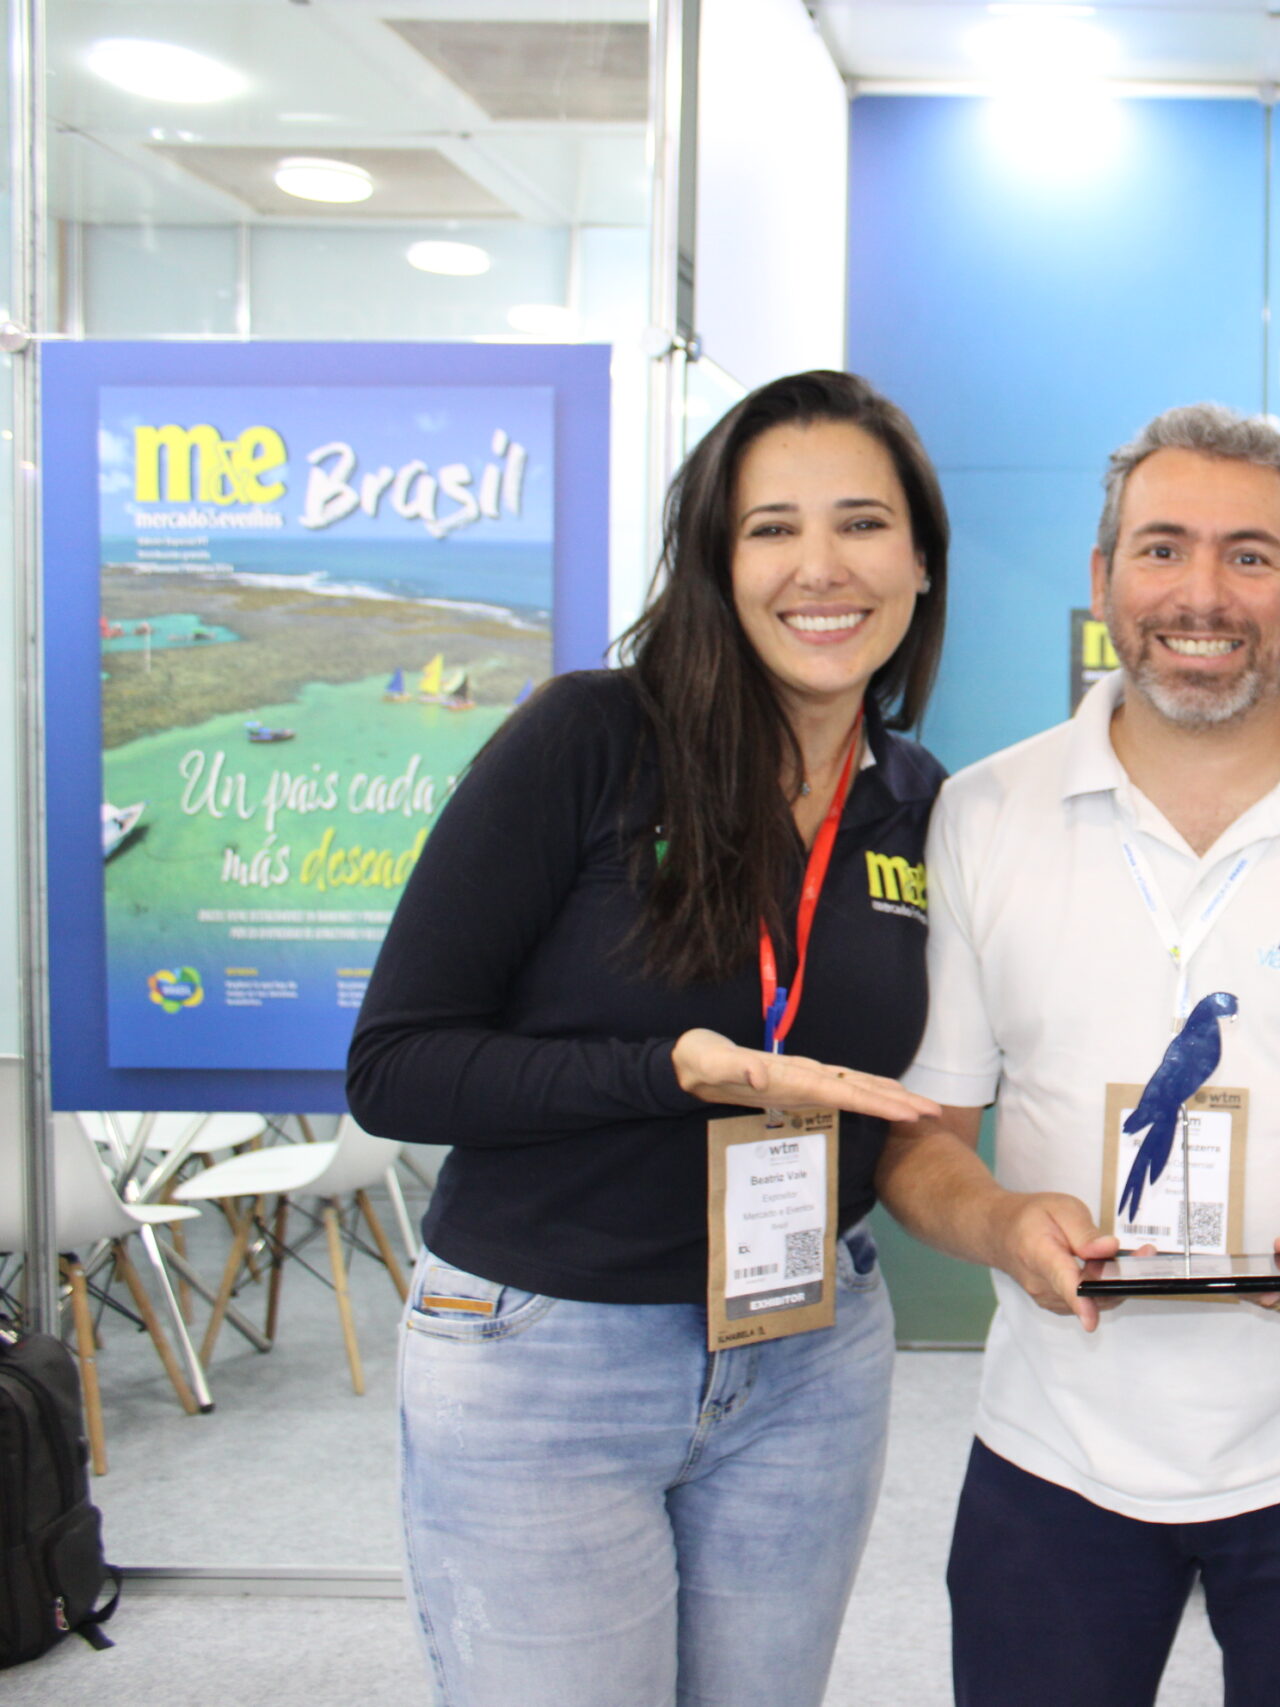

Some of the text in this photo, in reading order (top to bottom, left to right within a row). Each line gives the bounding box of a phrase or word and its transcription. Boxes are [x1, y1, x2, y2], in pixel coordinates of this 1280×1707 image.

[134, 424, 527, 539] m&e Brasil
[179, 750, 255, 818] Un
[348, 754, 434, 817] cada
[222, 826, 429, 892] más desead
[1210, 1092, 1241, 1104] wtm
[769, 1142, 799, 1155] wtm
